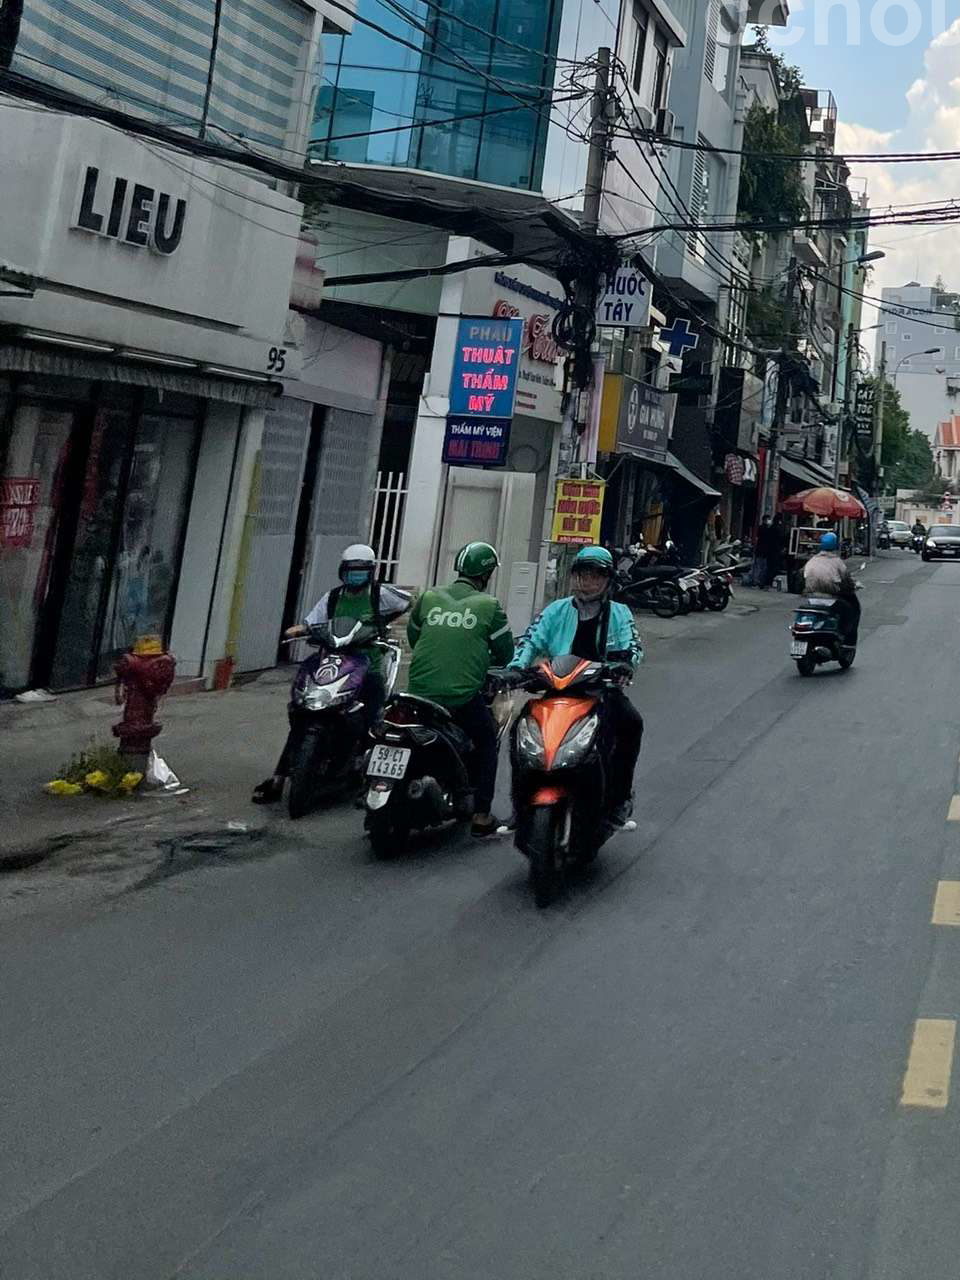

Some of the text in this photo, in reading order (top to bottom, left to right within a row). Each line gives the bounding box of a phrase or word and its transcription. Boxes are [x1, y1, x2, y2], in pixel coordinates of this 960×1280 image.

[78, 166, 187, 254] LIEU
[604, 268, 646, 296] HUỐC
[604, 298, 633, 322] TÂY
[266, 347, 287, 372] 95
[427, 606, 478, 630] Grab
